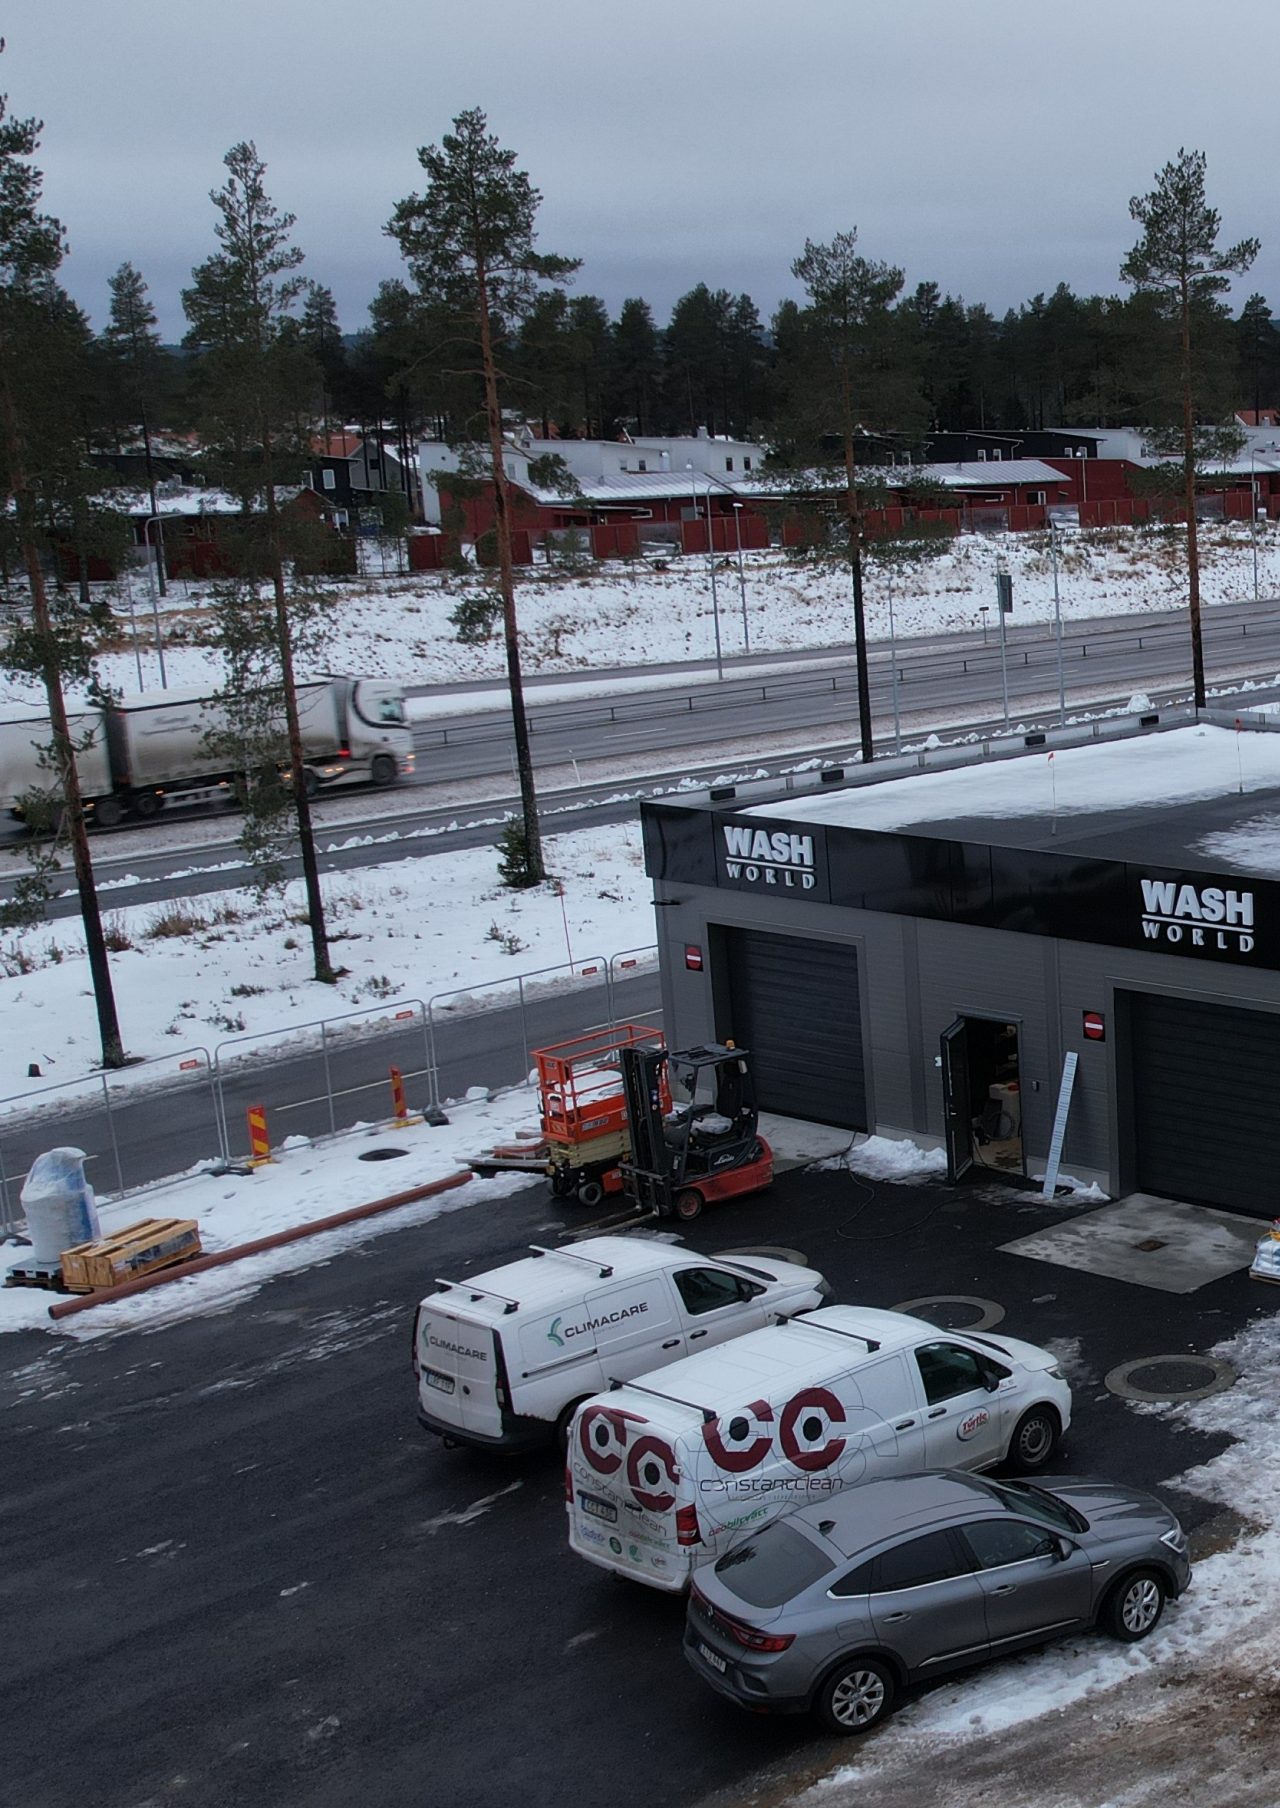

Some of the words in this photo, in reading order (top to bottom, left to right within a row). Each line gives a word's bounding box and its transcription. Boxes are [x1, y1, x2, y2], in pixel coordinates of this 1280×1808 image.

[723, 826, 814, 866] WASH
[726, 863, 815, 889] WORLD
[1140, 879, 1254, 926] WASH
[1142, 921, 1255, 953] WORLD
[564, 1302, 649, 1338] CLIMACARE
[429, 1335, 488, 1361] CLIMACARE
